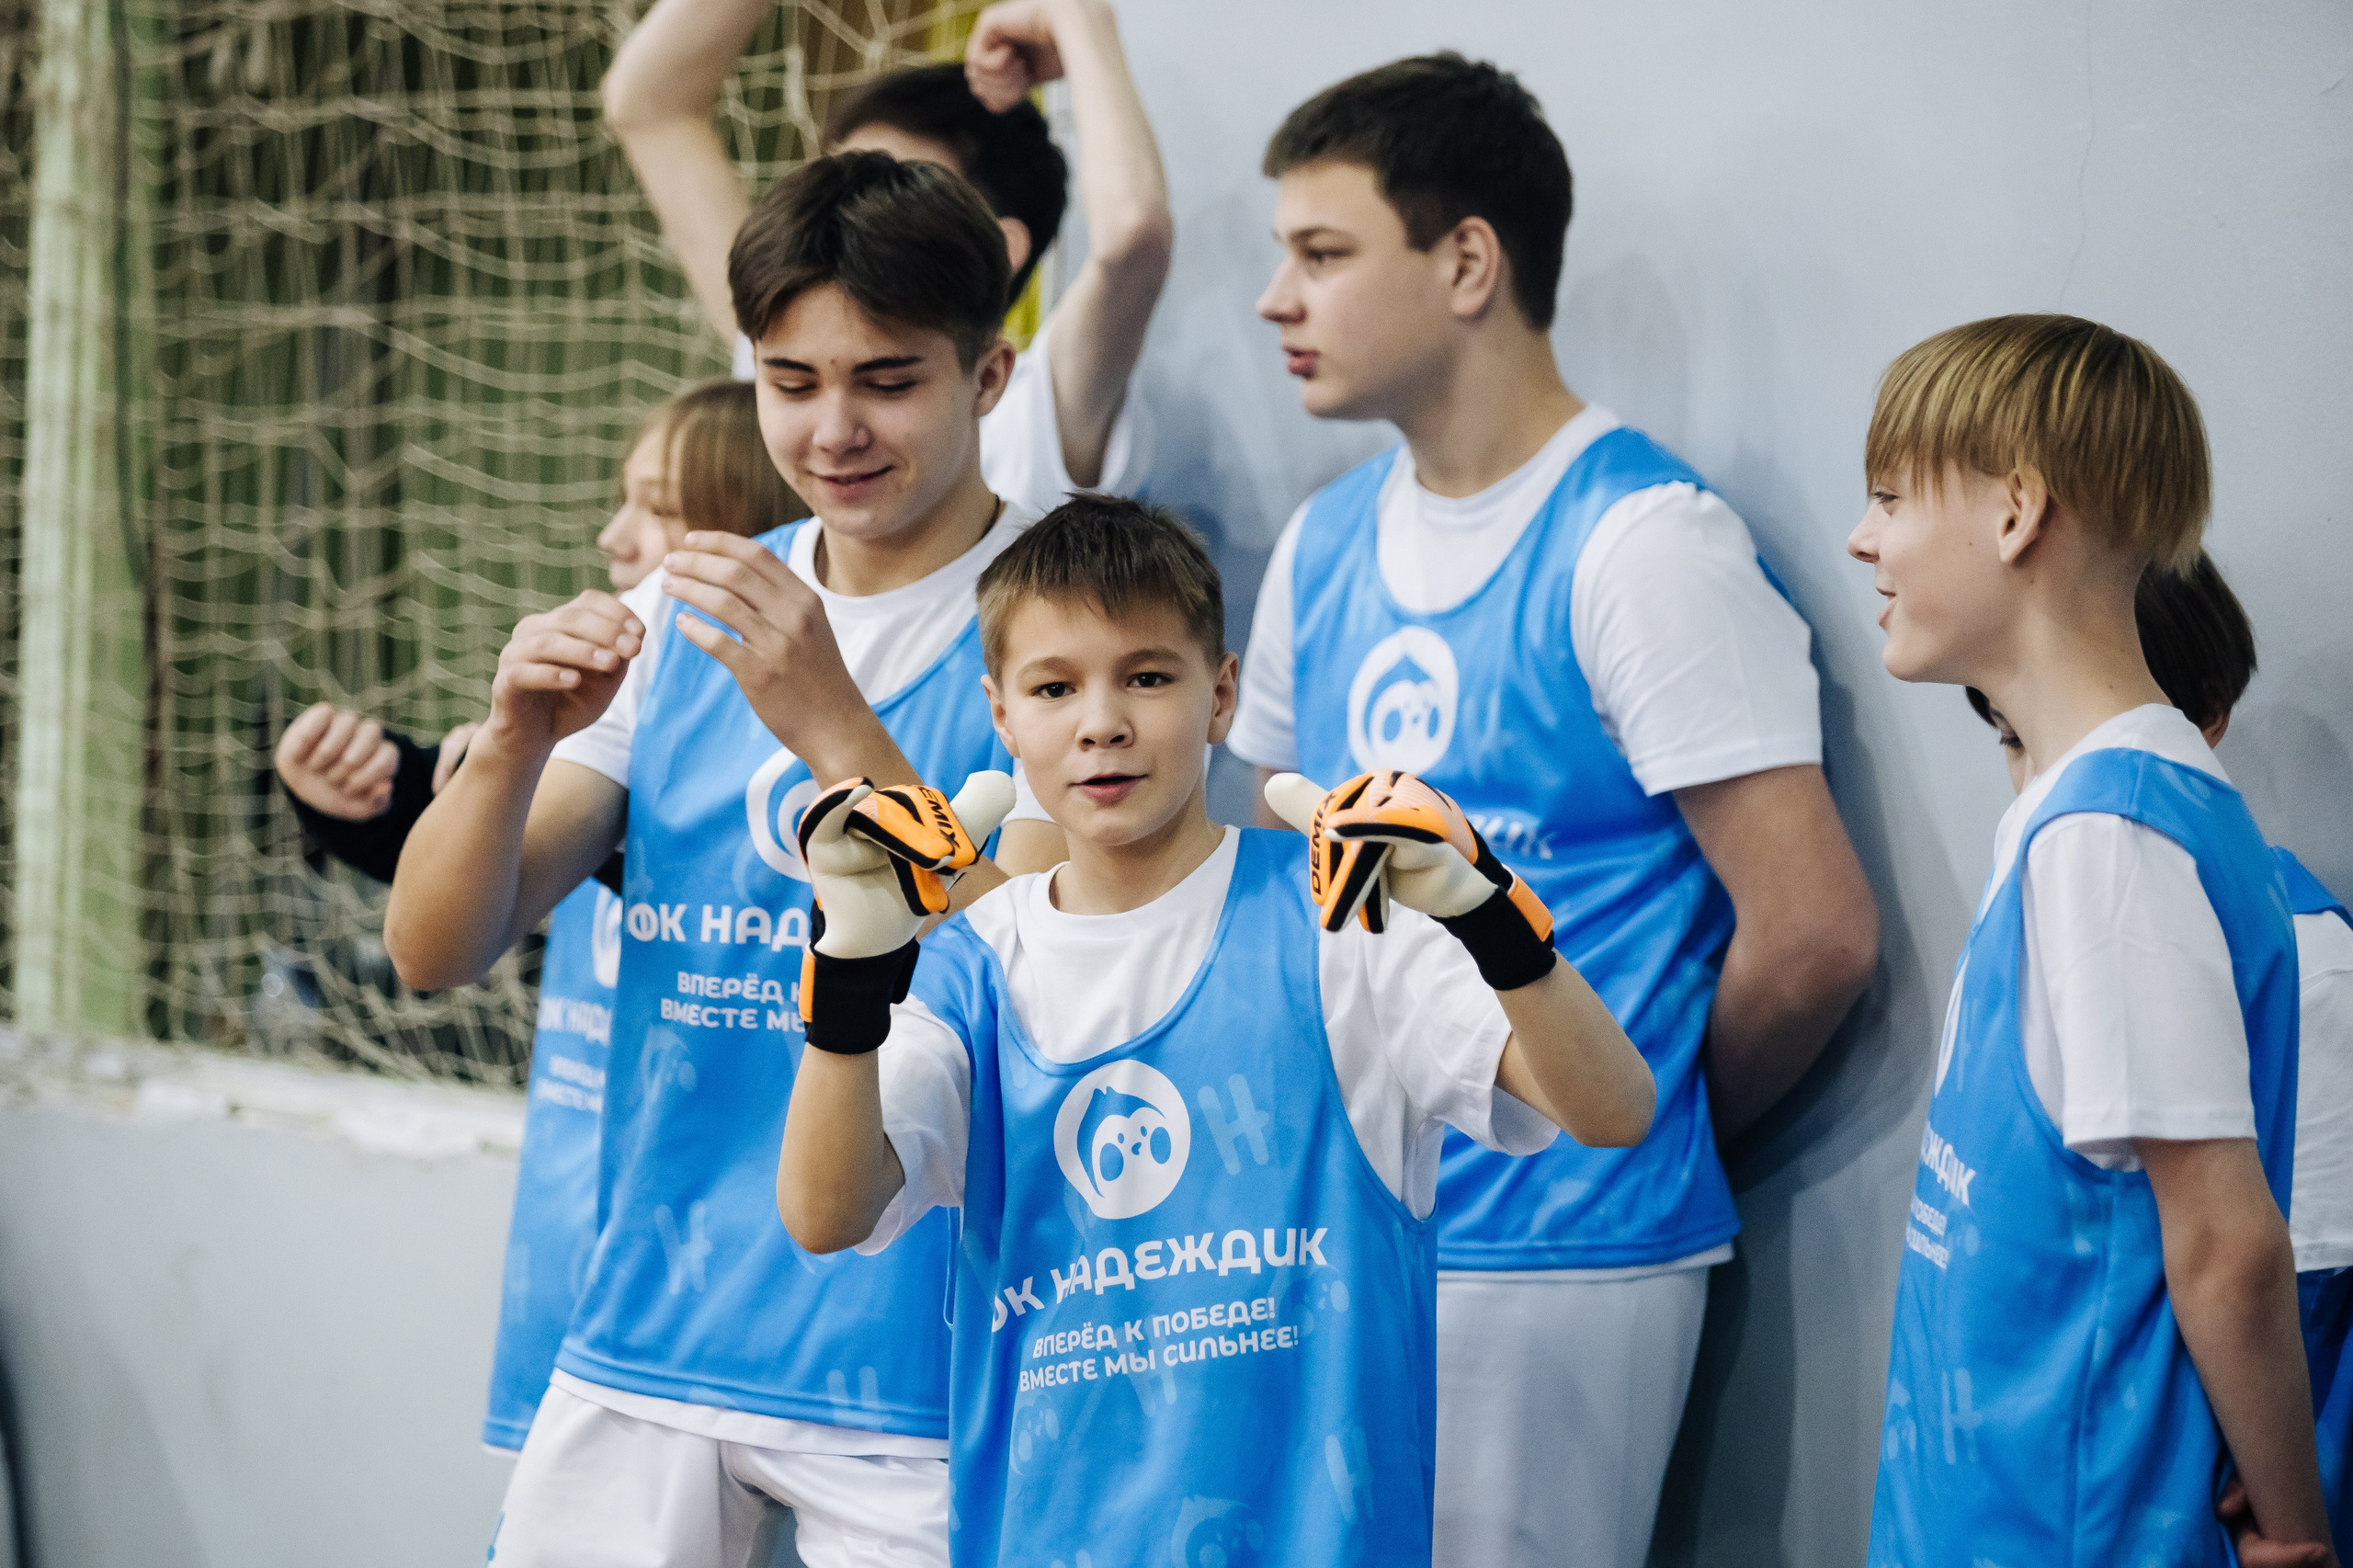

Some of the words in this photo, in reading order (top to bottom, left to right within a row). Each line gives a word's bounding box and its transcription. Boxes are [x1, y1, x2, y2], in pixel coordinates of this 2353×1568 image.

[916, 785, 961, 848] EMIX
[1311, 791, 1336, 895] DEMIX
[660, 997, 758, 1029] ВМЕСТЕ
[676, 971, 783, 1005] ВПЕРЁД
[1050, 1227, 1329, 1305] НАДЕЖДИК
[1019, 1358, 1098, 1392] ВМЕСТЕ
[1104, 1348, 1156, 1377] МЫ
[1163, 1324, 1300, 1367] СИЛЬНЕЕ!
[1032, 1321, 1118, 1359] ВПЕРЁД
[1124, 1319, 1145, 1343] К
[1153, 1297, 1276, 1338] ПОБЕДЕ!
